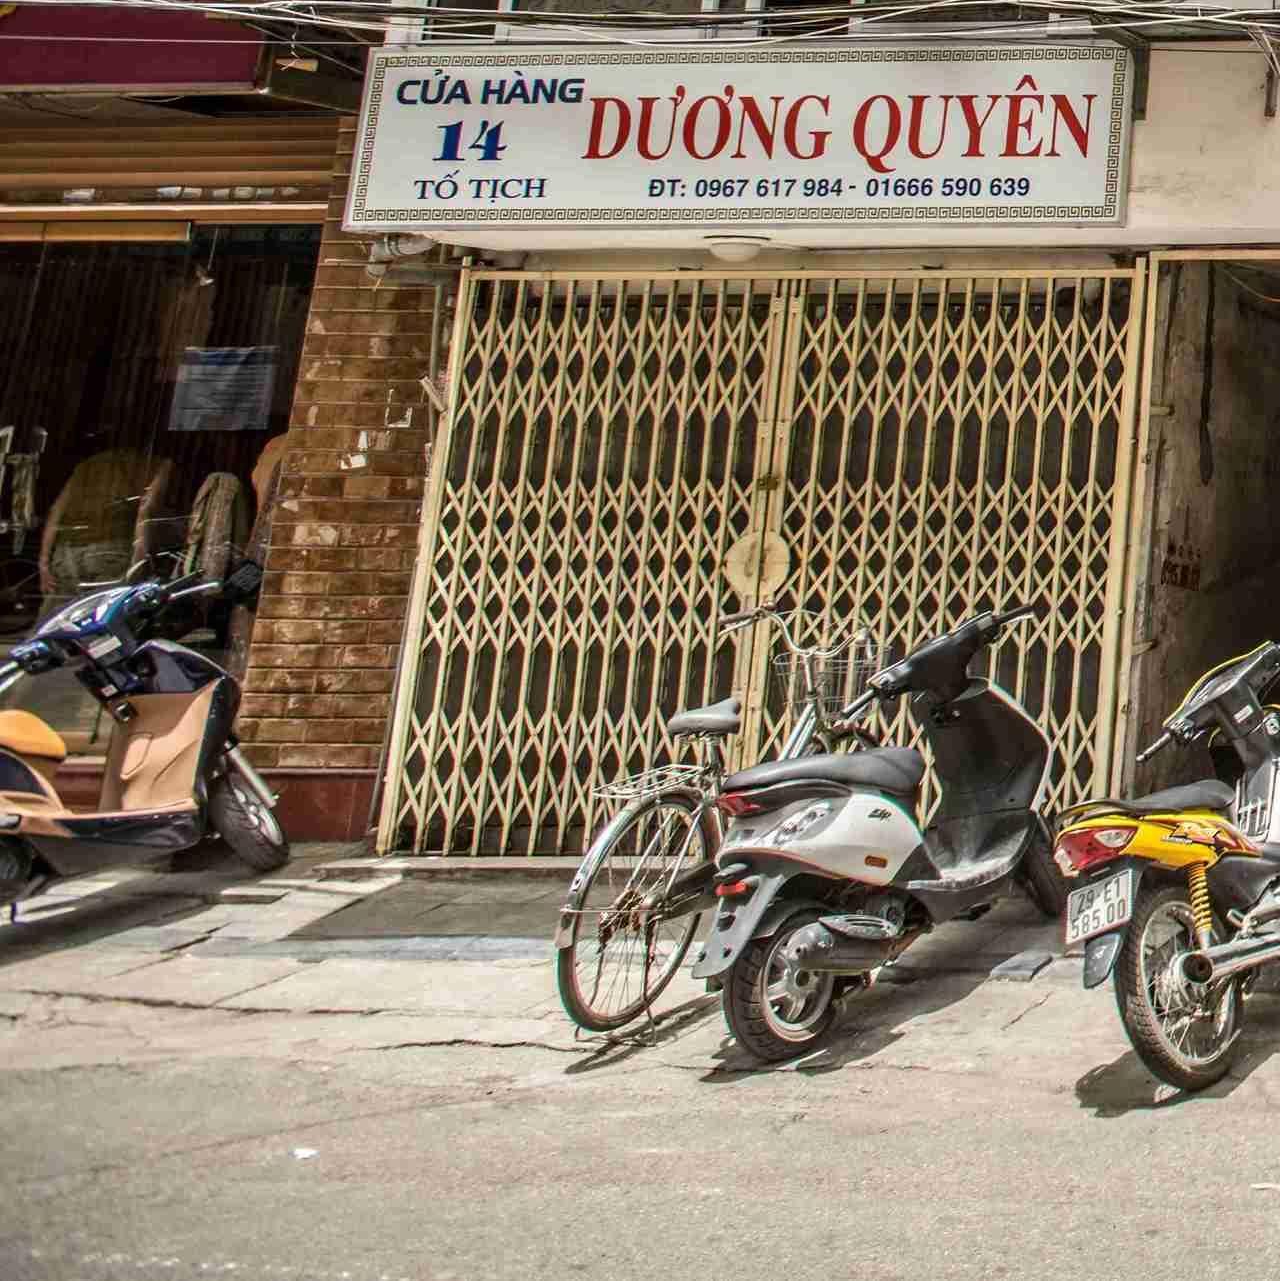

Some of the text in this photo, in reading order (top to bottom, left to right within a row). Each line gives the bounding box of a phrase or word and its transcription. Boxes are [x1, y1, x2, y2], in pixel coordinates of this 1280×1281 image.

[395, 69, 586, 105] CỬA HÀNG
[431, 119, 508, 162] 14
[581, 74, 1098, 173] DƯƠNG QUYÊN
[468, 177, 548, 204] TỊCH
[648, 179, 687, 198] ĐT:
[695, 179, 748, 198] 0967
[756, 178, 796, 197] 617
[802, 178, 843, 197] 984
[865, 178, 933, 197] 01666
[941, 177, 981, 196] 590
[989, 177, 1030, 196] 639
